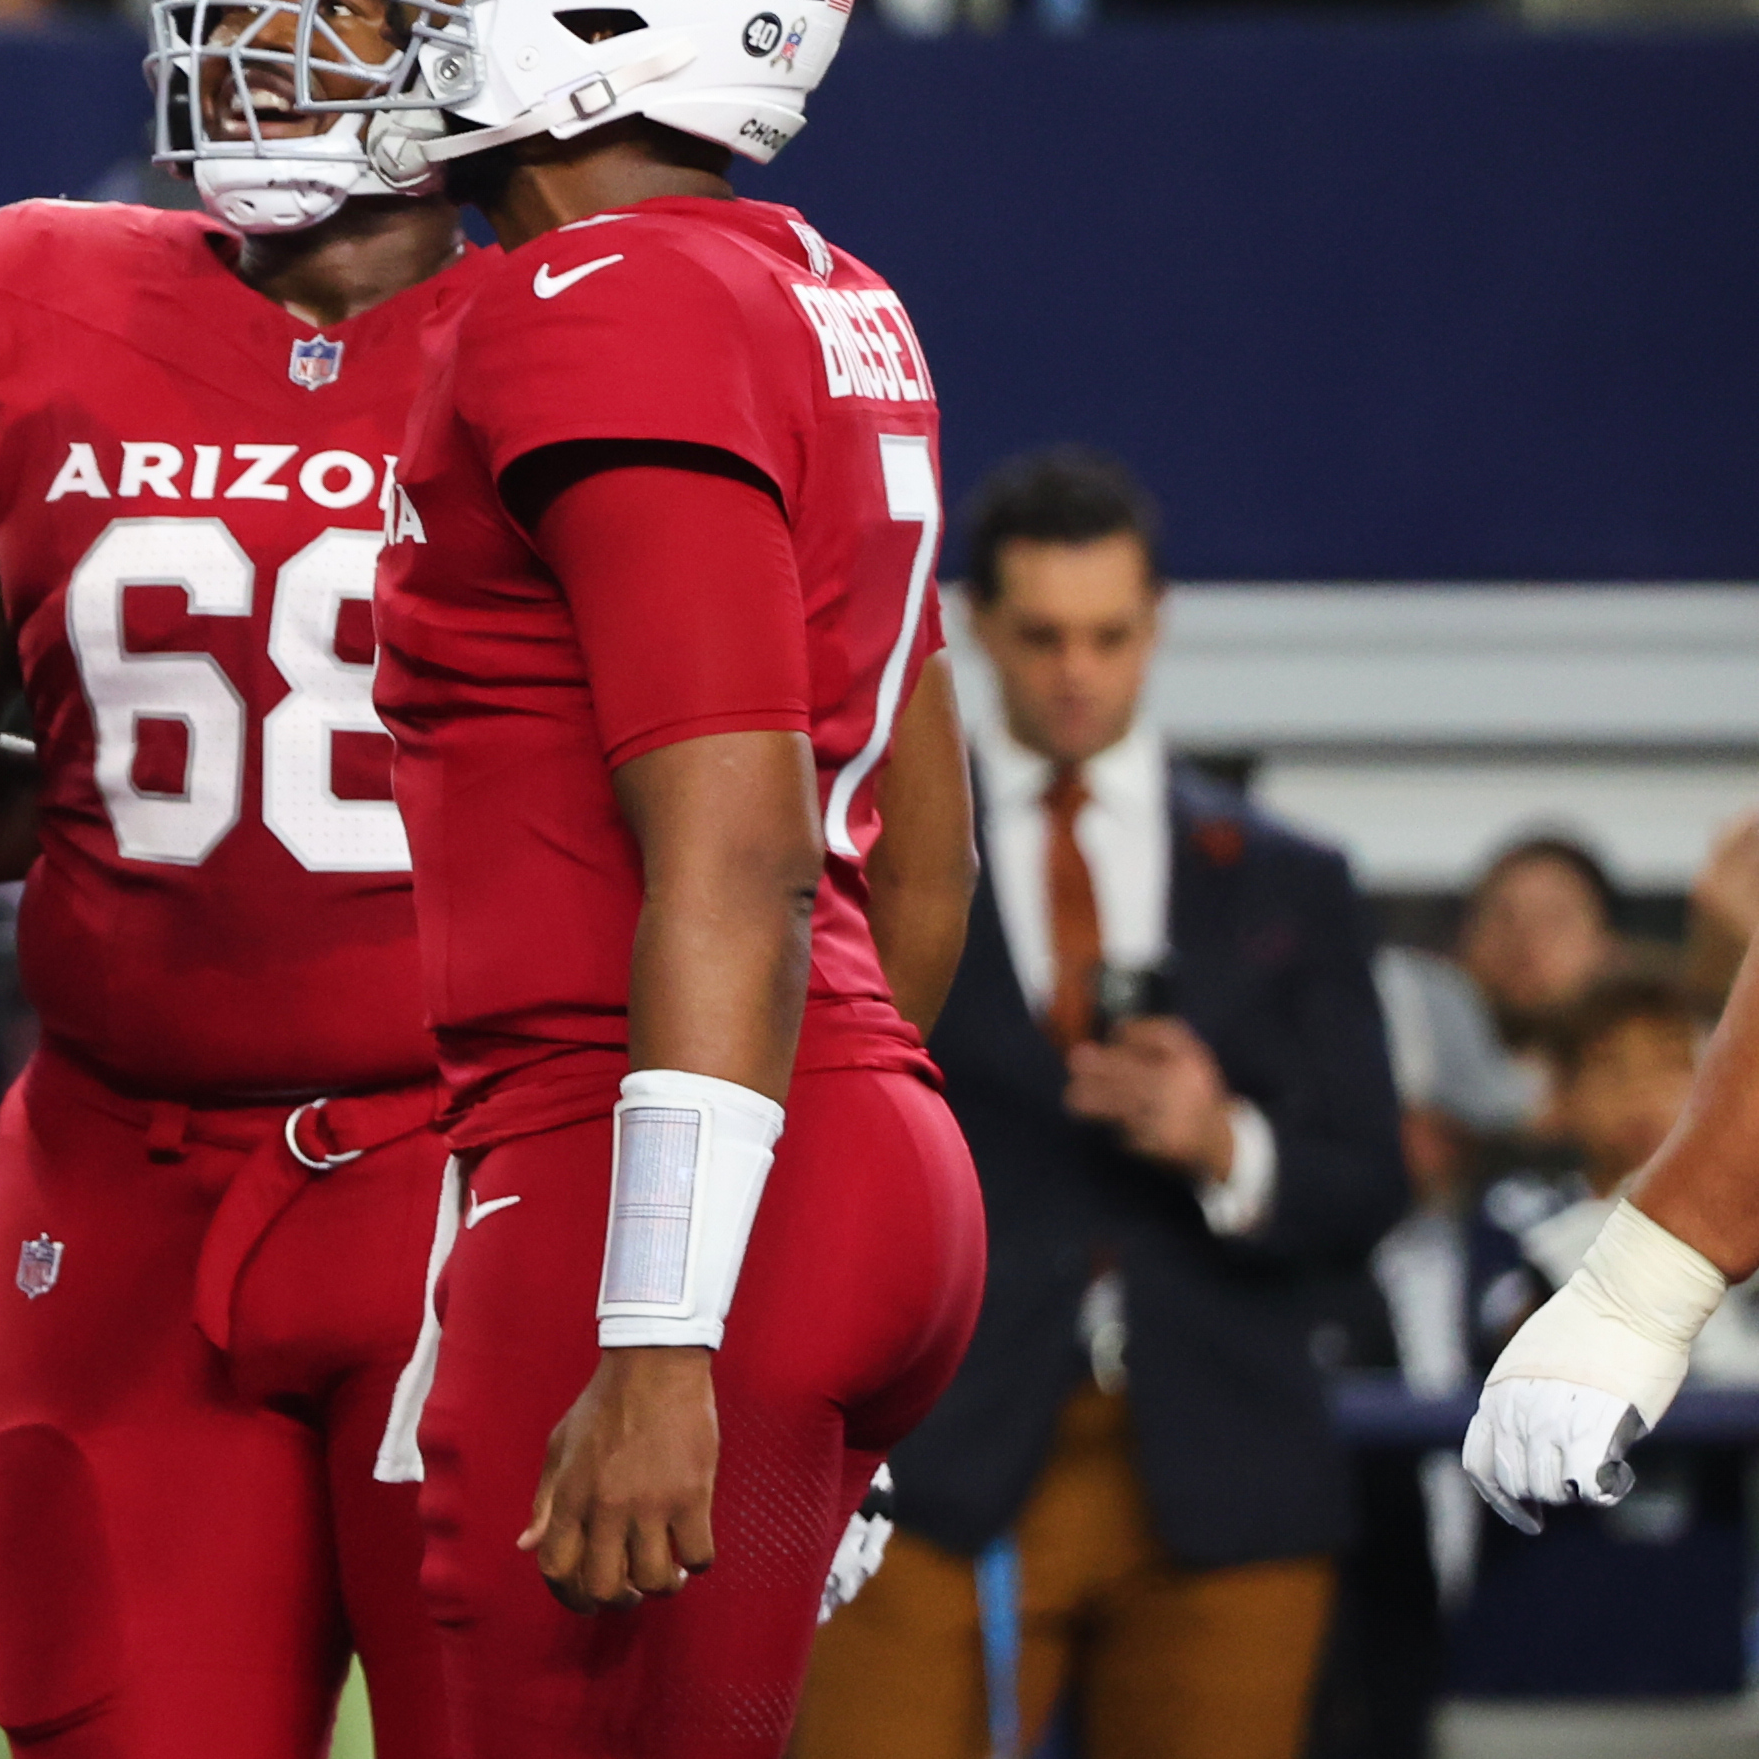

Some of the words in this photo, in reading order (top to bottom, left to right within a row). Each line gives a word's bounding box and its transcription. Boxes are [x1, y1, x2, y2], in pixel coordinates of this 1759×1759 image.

[748, 18, 779, 51] 40
[791, 284, 936, 402] BRISSET
[65, 517, 414, 872] 68
[825, 433, 939, 857] 7
